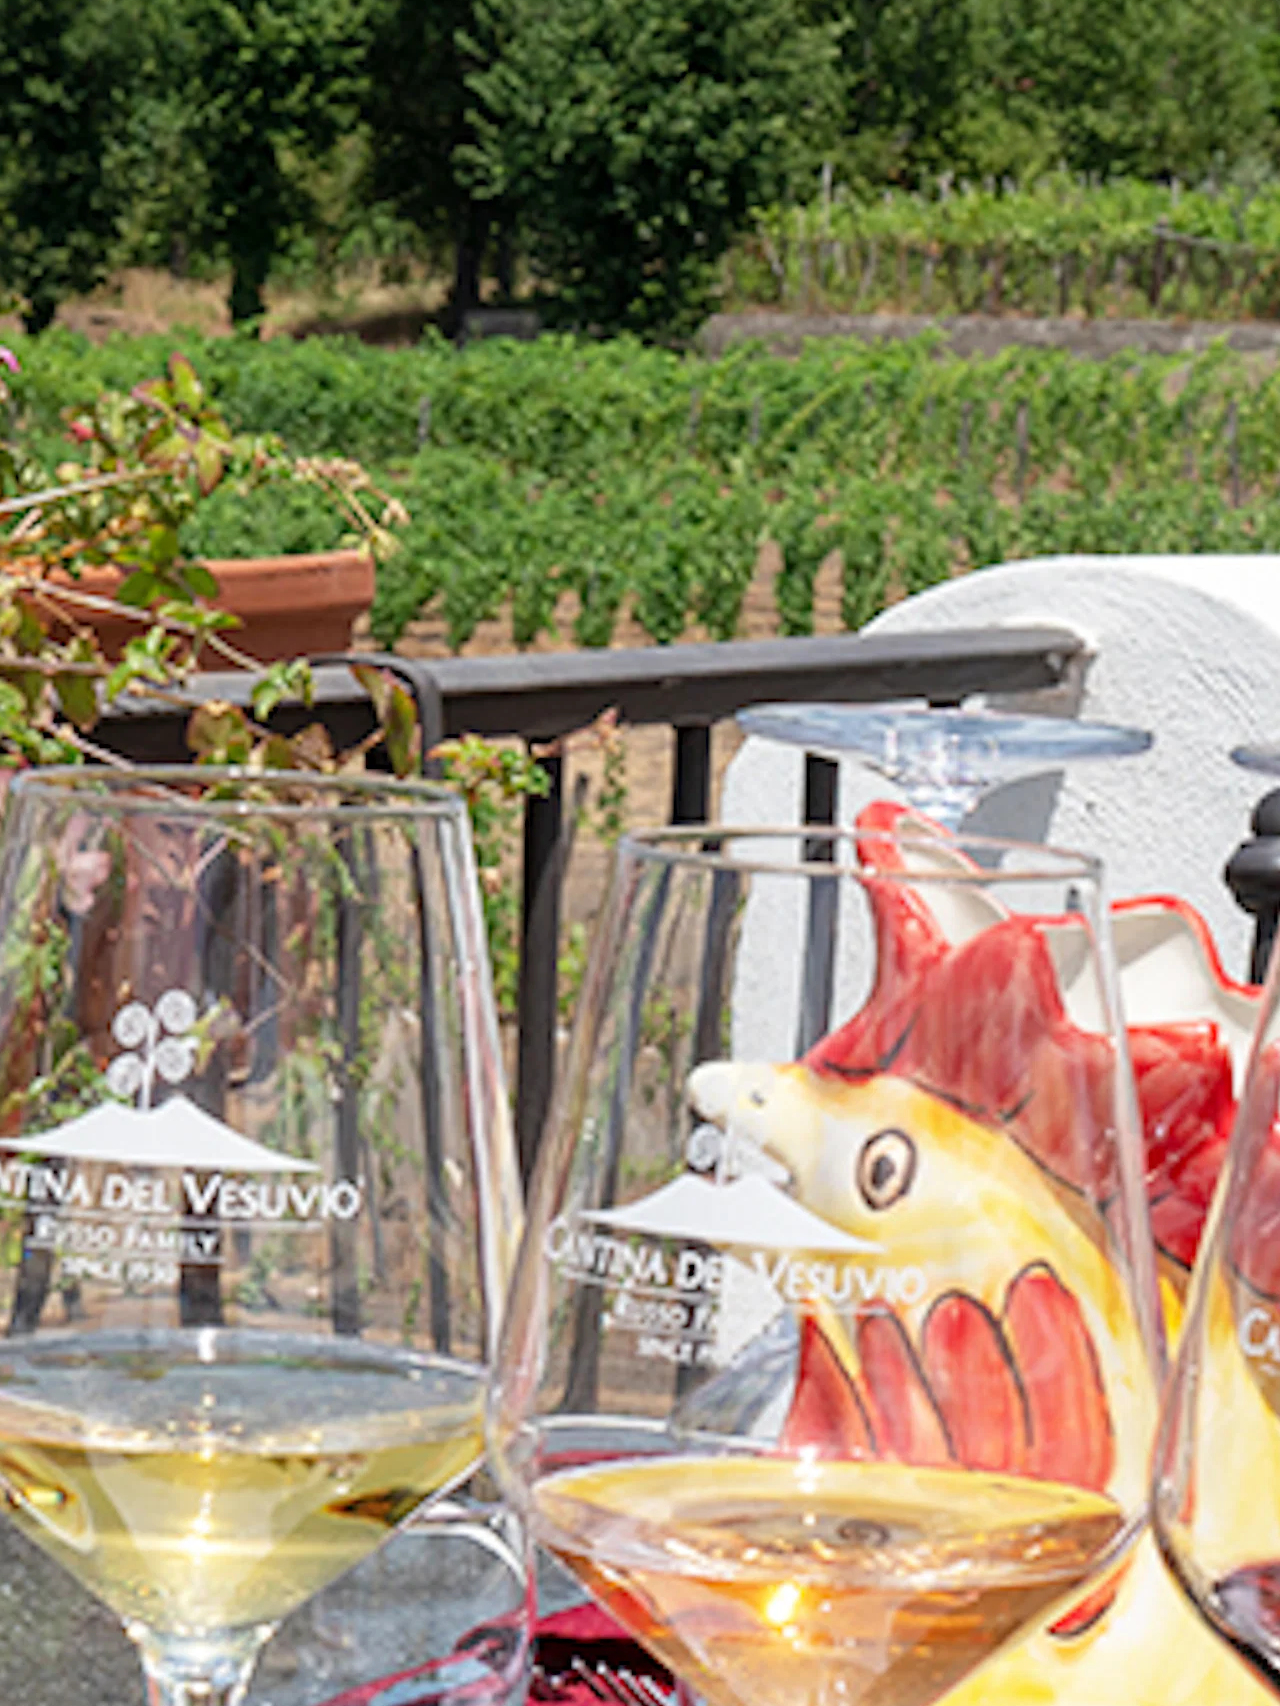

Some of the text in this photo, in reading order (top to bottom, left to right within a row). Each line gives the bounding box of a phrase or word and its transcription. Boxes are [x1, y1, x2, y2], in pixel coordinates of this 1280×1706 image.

[101, 1174, 172, 1213] DEL
[182, 1174, 361, 1219] VESUVIO
[122, 1221, 219, 1259] FAMILY
[543, 1216, 926, 1302] CANTINA DE VESUVIO
